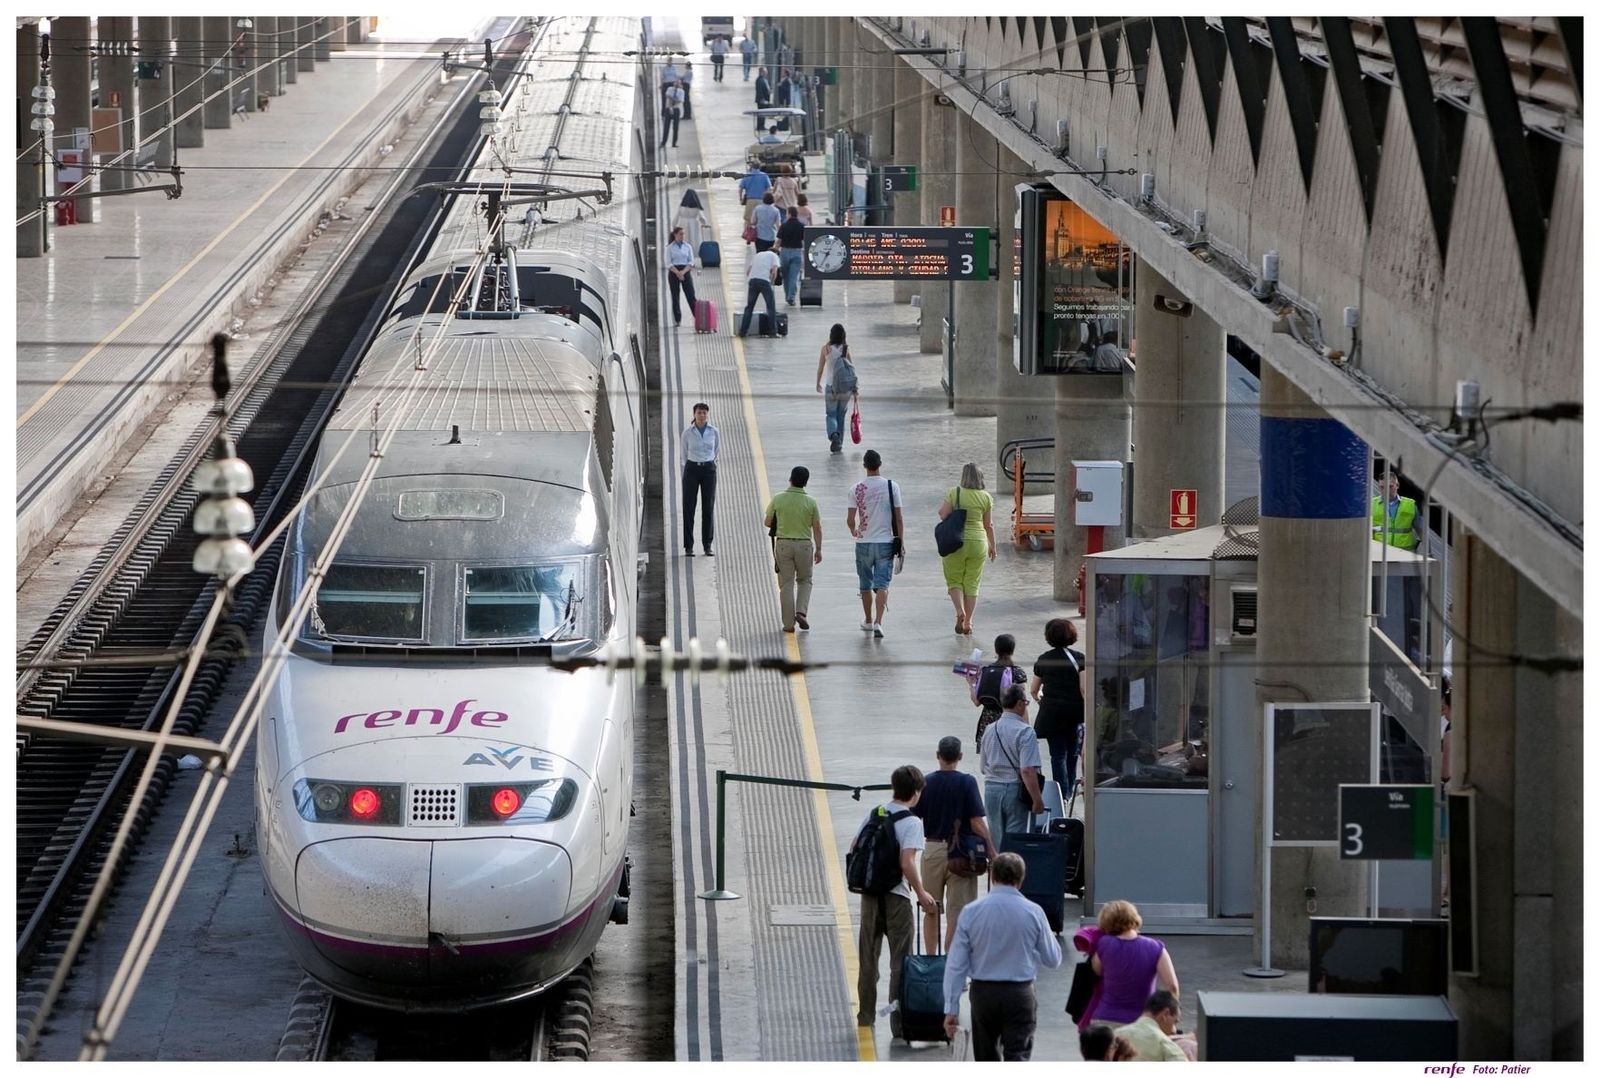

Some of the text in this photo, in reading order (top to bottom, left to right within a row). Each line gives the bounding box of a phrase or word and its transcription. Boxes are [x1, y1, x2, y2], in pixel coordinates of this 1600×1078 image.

[814, 75, 821, 86] 3
[885, 178, 893, 191] 3
[961, 254, 973, 274] 3
[1053, 303, 1085, 311] Seguimos
[1086, 303, 1120, 311] trabajando
[334, 699, 509, 735] renfe
[462, 749, 554, 772] AVE
[1344, 822, 1364, 856] 3
